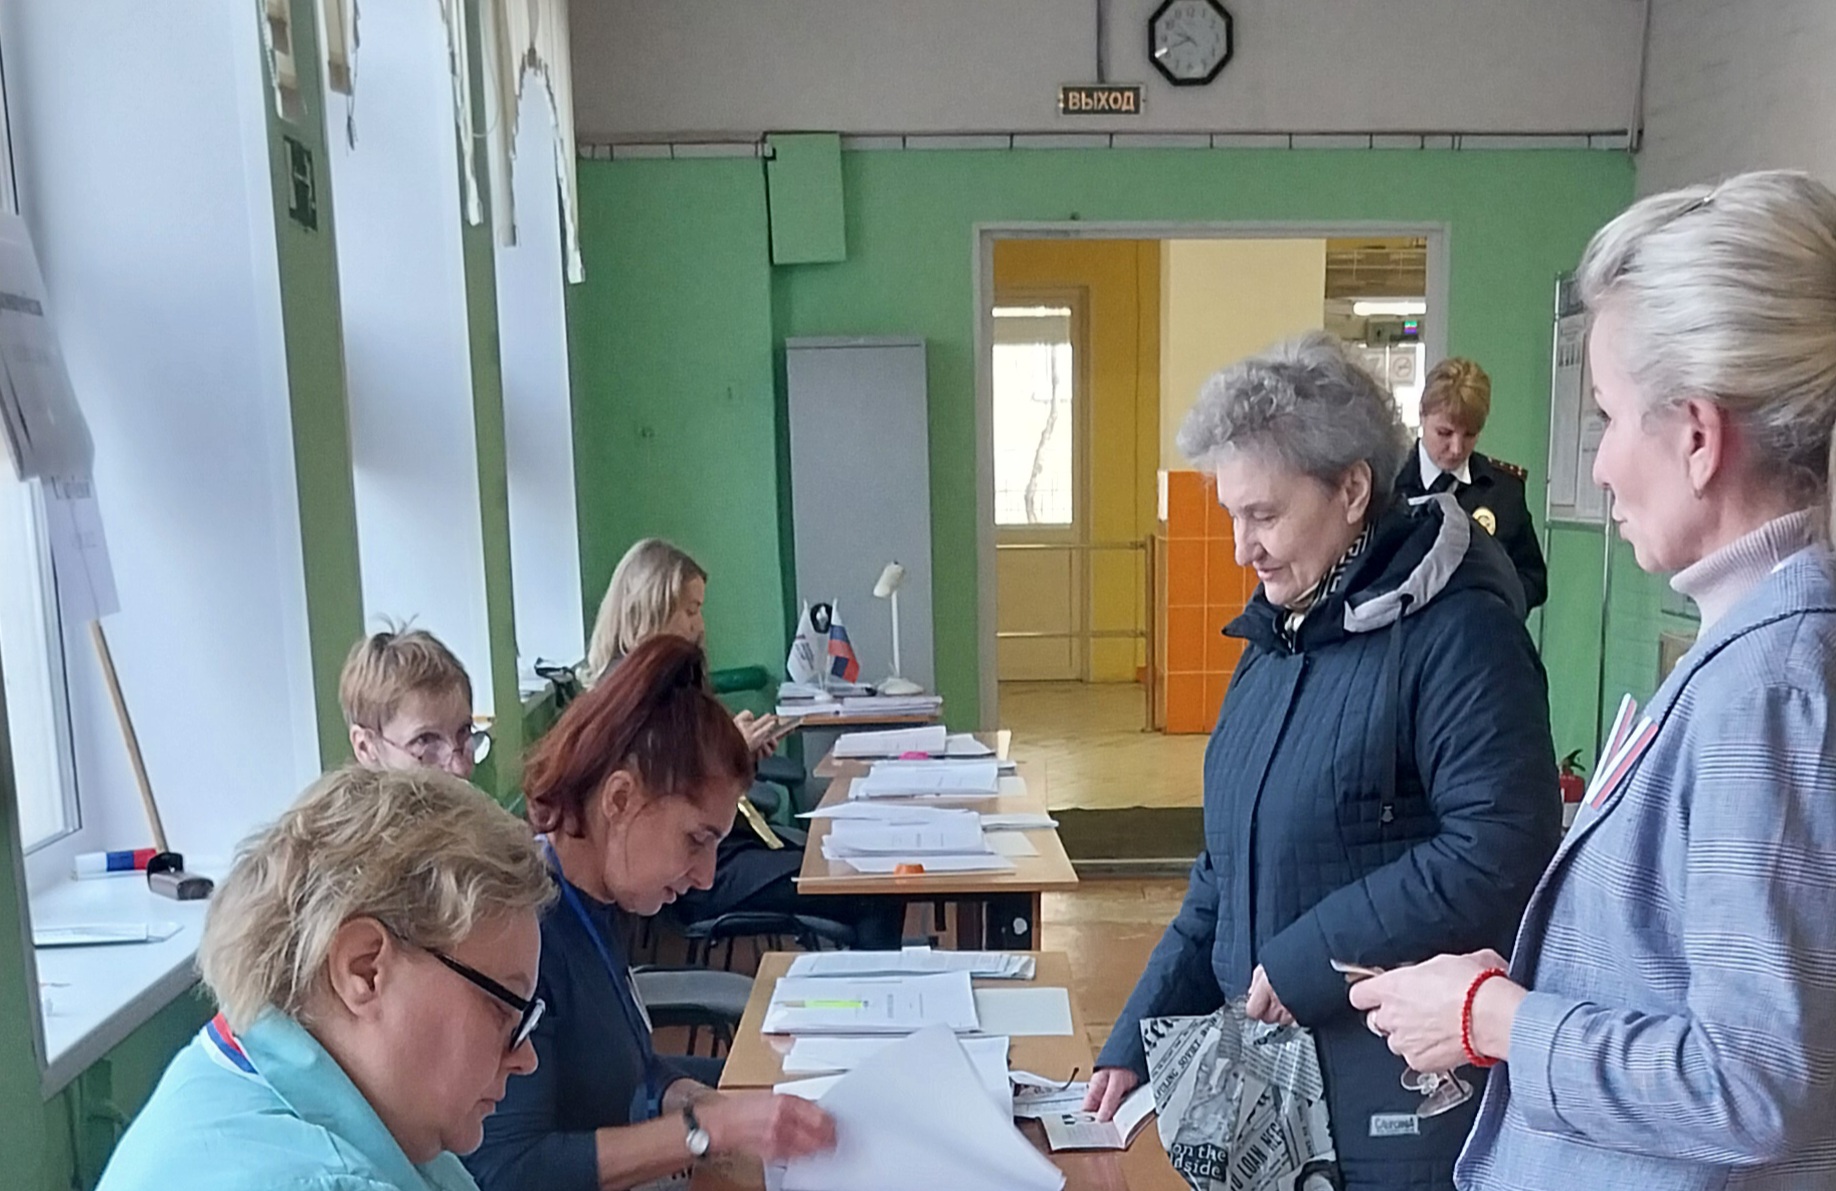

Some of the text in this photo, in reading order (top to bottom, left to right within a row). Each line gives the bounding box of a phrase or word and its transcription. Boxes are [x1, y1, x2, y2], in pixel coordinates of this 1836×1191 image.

[1068, 91, 1135, 112] ВЫХОД
[1172, 1142, 1227, 1163] on the
[1236, 1145, 1268, 1180] LOAN
